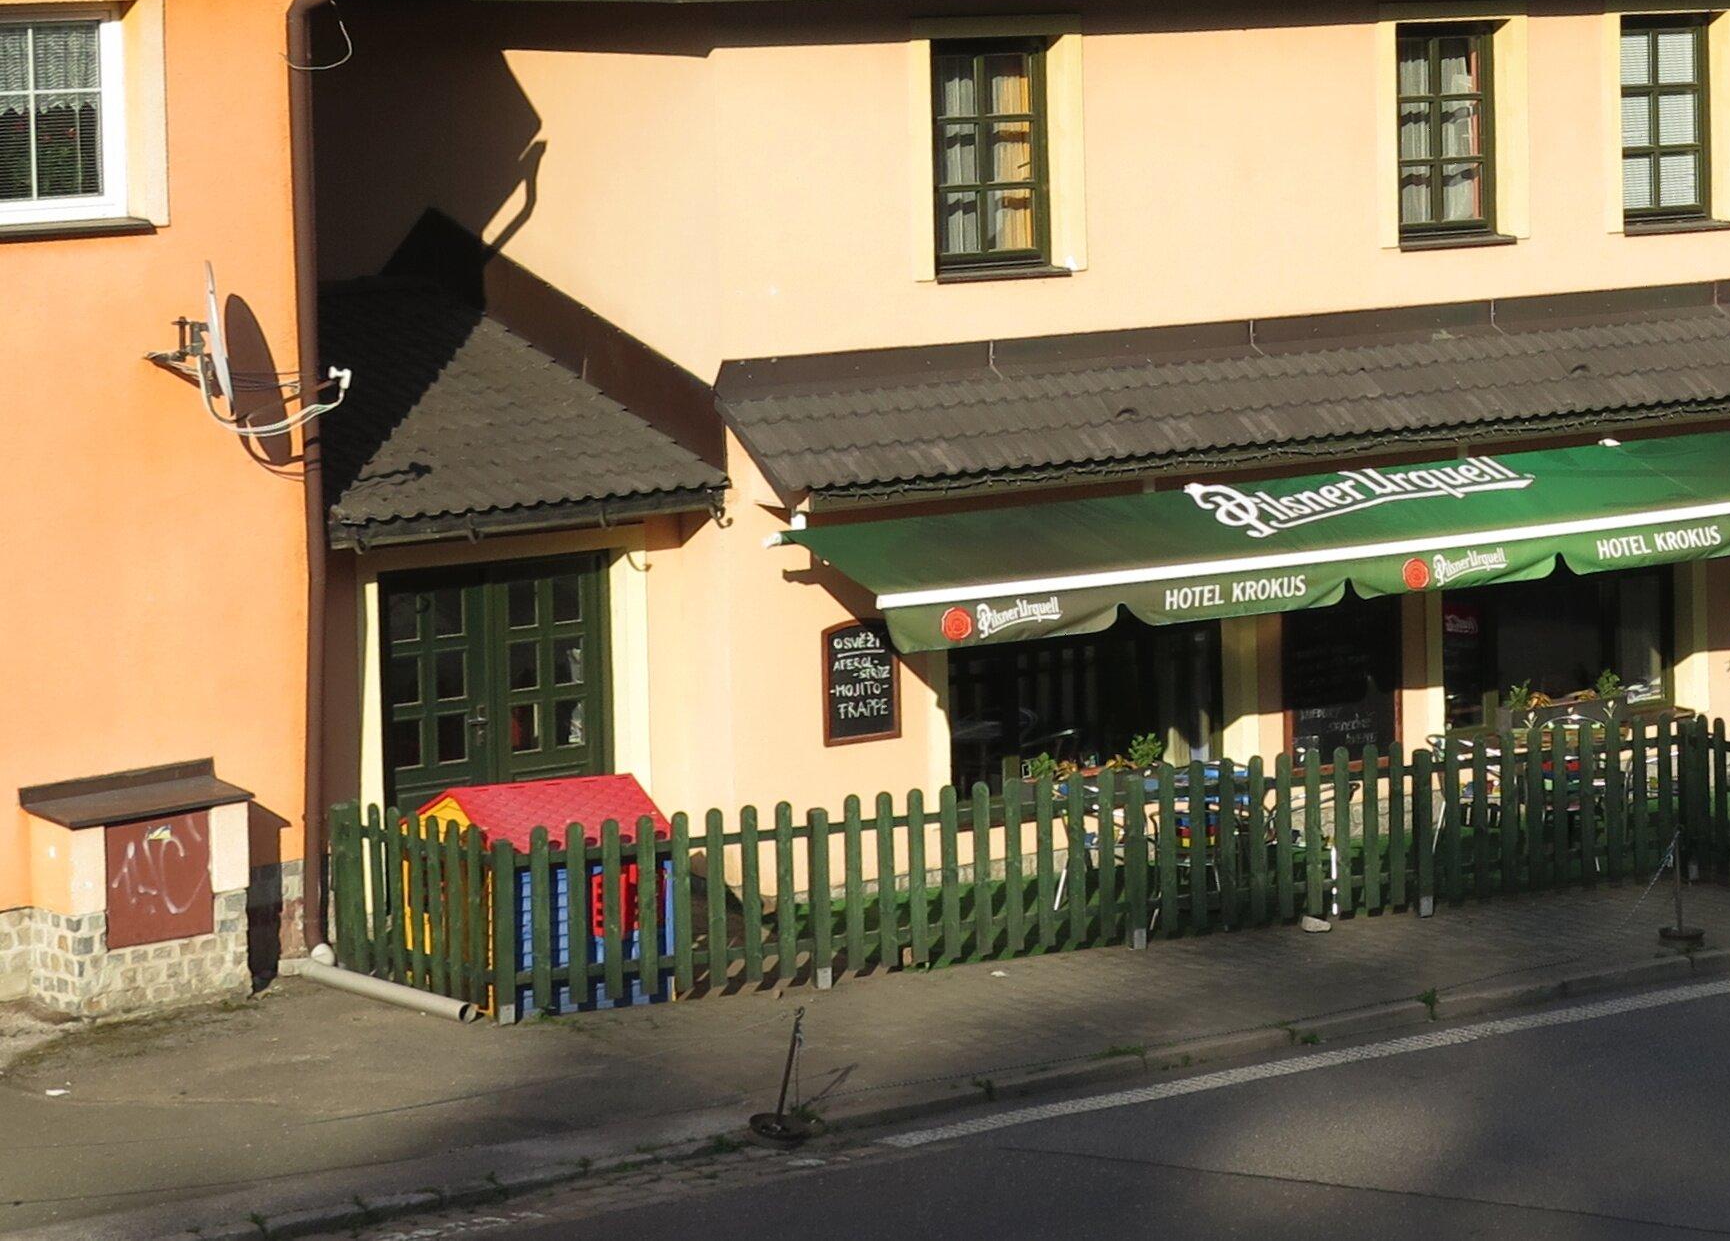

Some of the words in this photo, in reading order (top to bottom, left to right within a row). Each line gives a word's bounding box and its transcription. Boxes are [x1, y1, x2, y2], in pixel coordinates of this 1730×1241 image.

[1184, 480, 1360, 538] Pilsner
[1337, 456, 1519, 499] Urquell
[1597, 535, 1653, 561] HOTEL
[1654, 525, 1722, 552] KROKUS
[1433, 553, 1471, 586] Pilsner
[1467, 547, 1508, 571] Urquell
[1165, 584, 1225, 611] HOTEL
[1232, 575, 1307, 602] KROKUS
[976, 603, 1019, 639] Pilsner
[1016, 596, 1060, 622] Urquell
